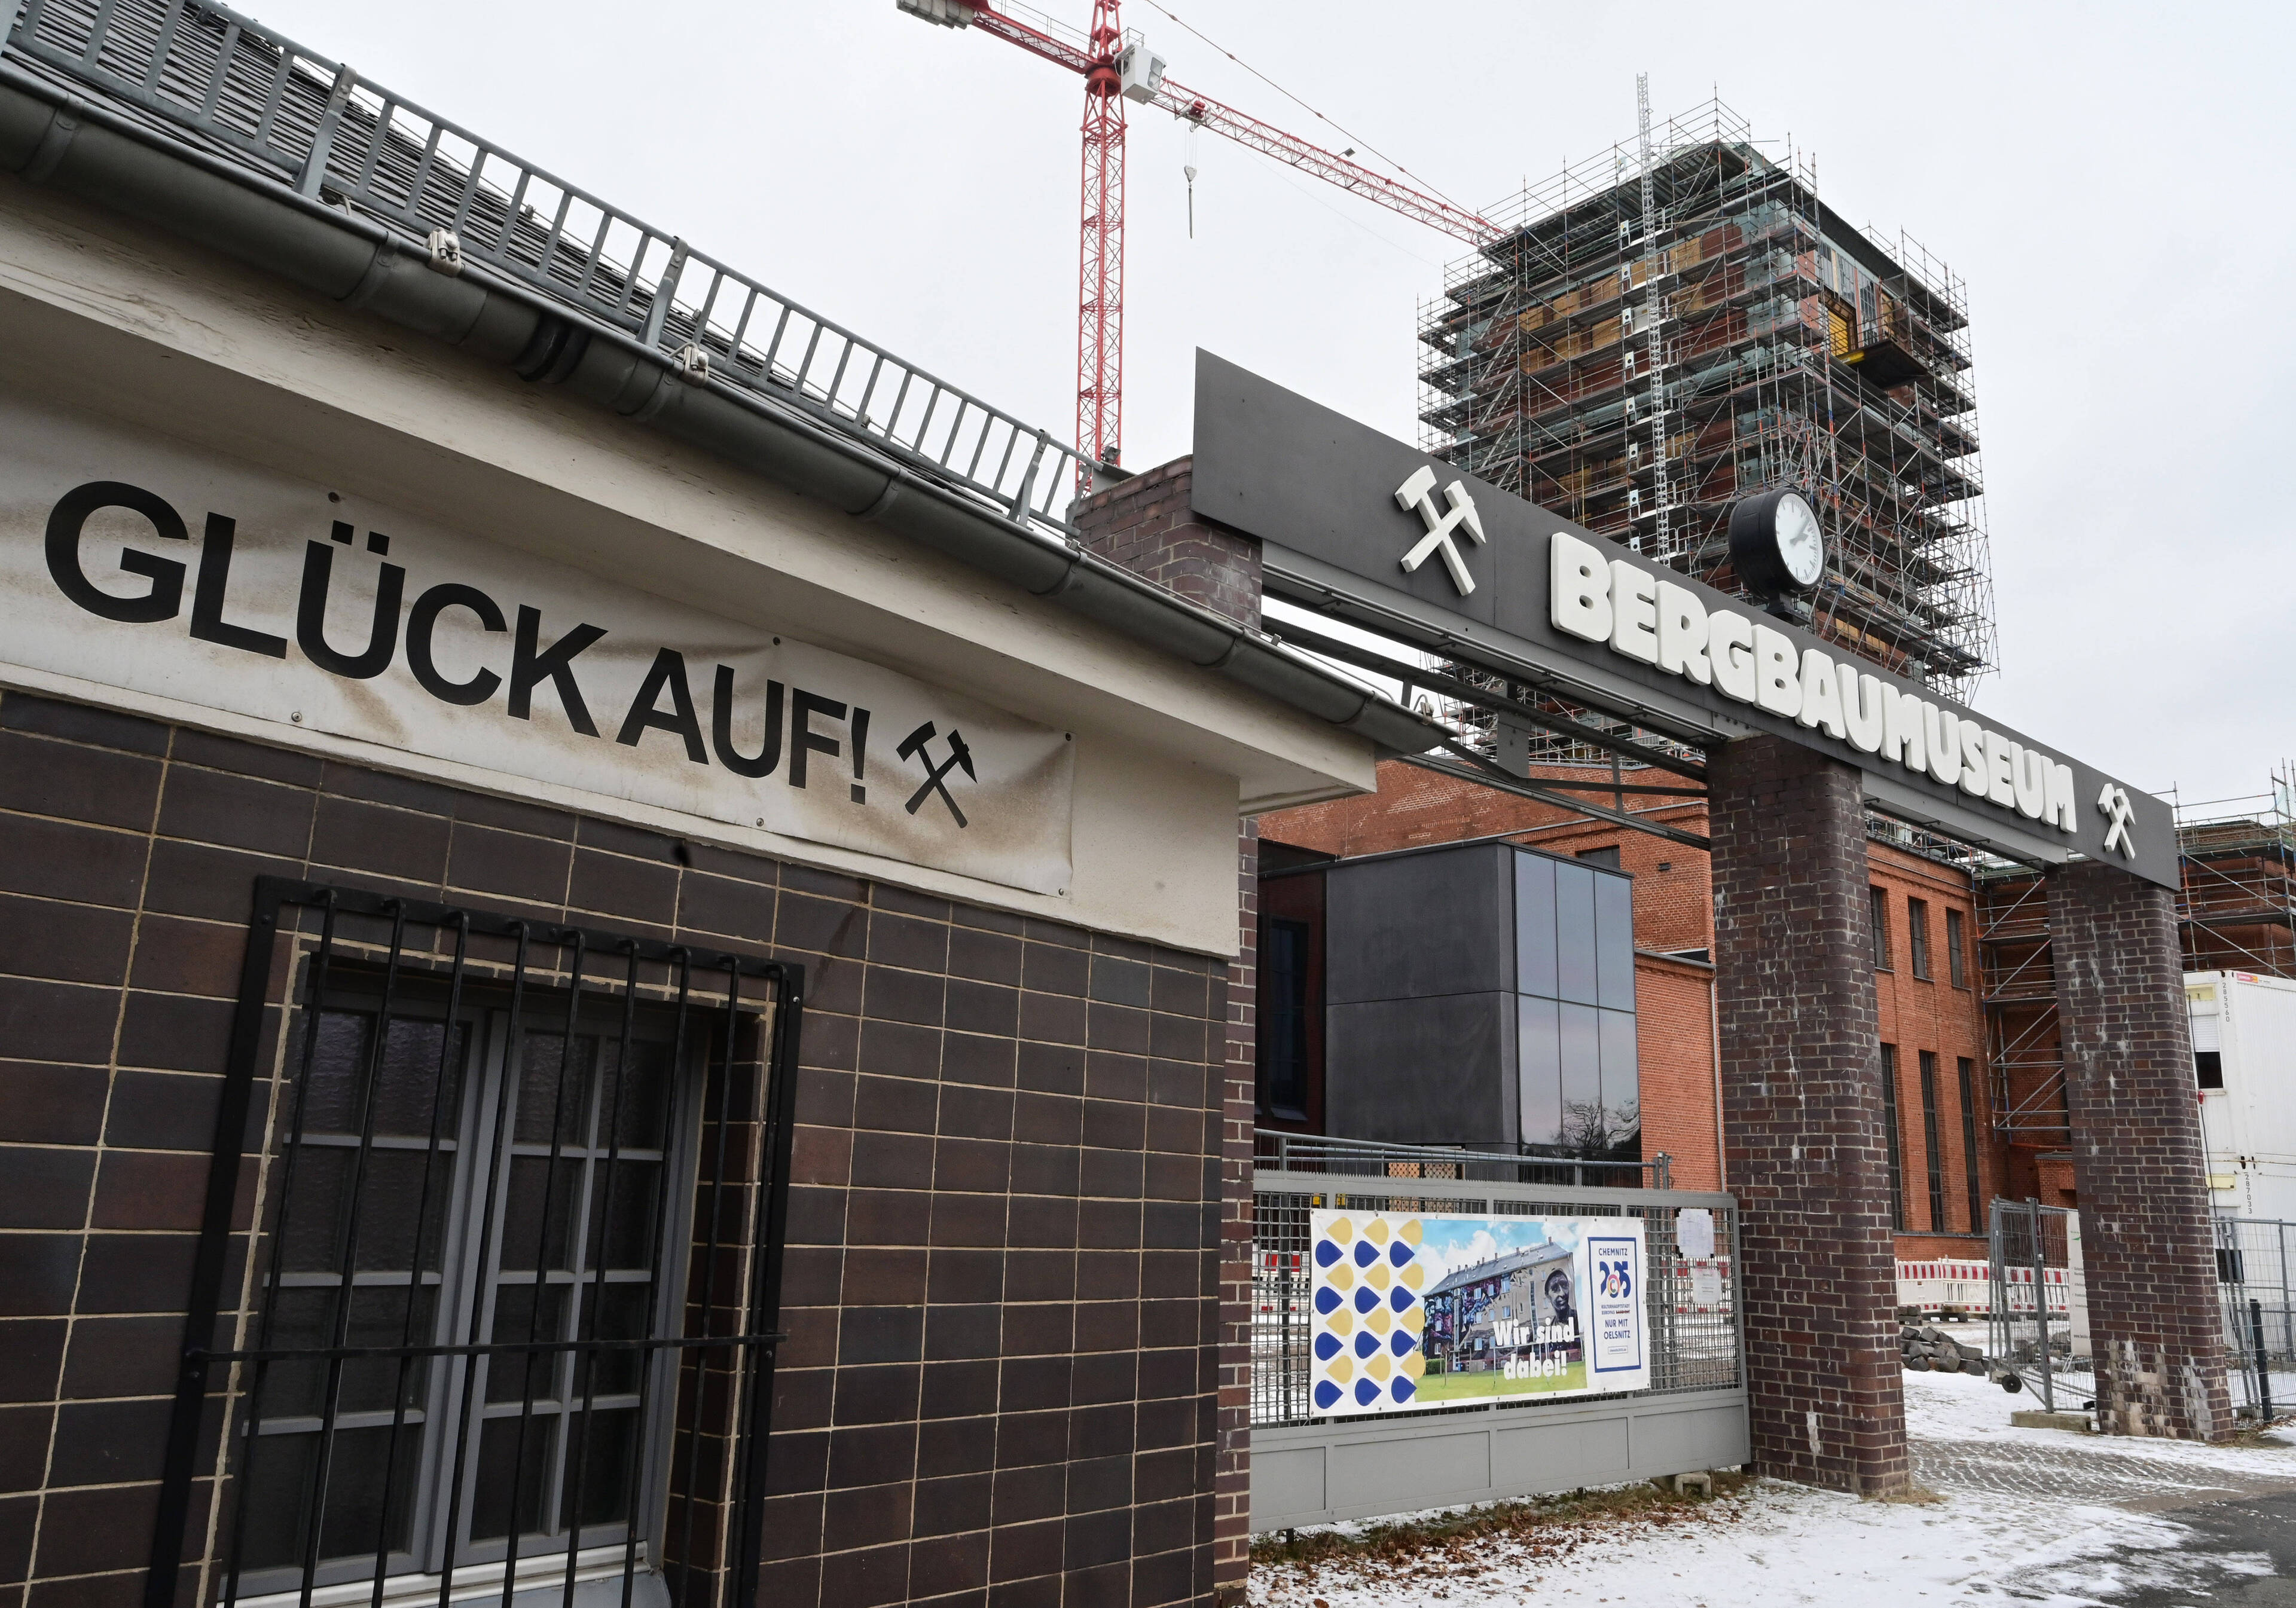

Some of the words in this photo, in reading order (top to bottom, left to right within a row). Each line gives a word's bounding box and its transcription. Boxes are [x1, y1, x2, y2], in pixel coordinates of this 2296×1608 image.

[1551, 531, 2077, 833] BERGBAUMUSEUM
[2222, 982, 2230, 1022] 285560
[1598, 1248, 1628, 1256] CHEMNITZ
[1492, 1319, 1530, 1346] Wir
[1536, 1316, 1575, 1344] sind
[1604, 1330, 1631, 1340] OELSNITZ
[1605, 1319, 1617, 1328] NUR
[1618, 1319, 1628, 1327] MIT
[1503, 1350, 1568, 1380] dabei!
